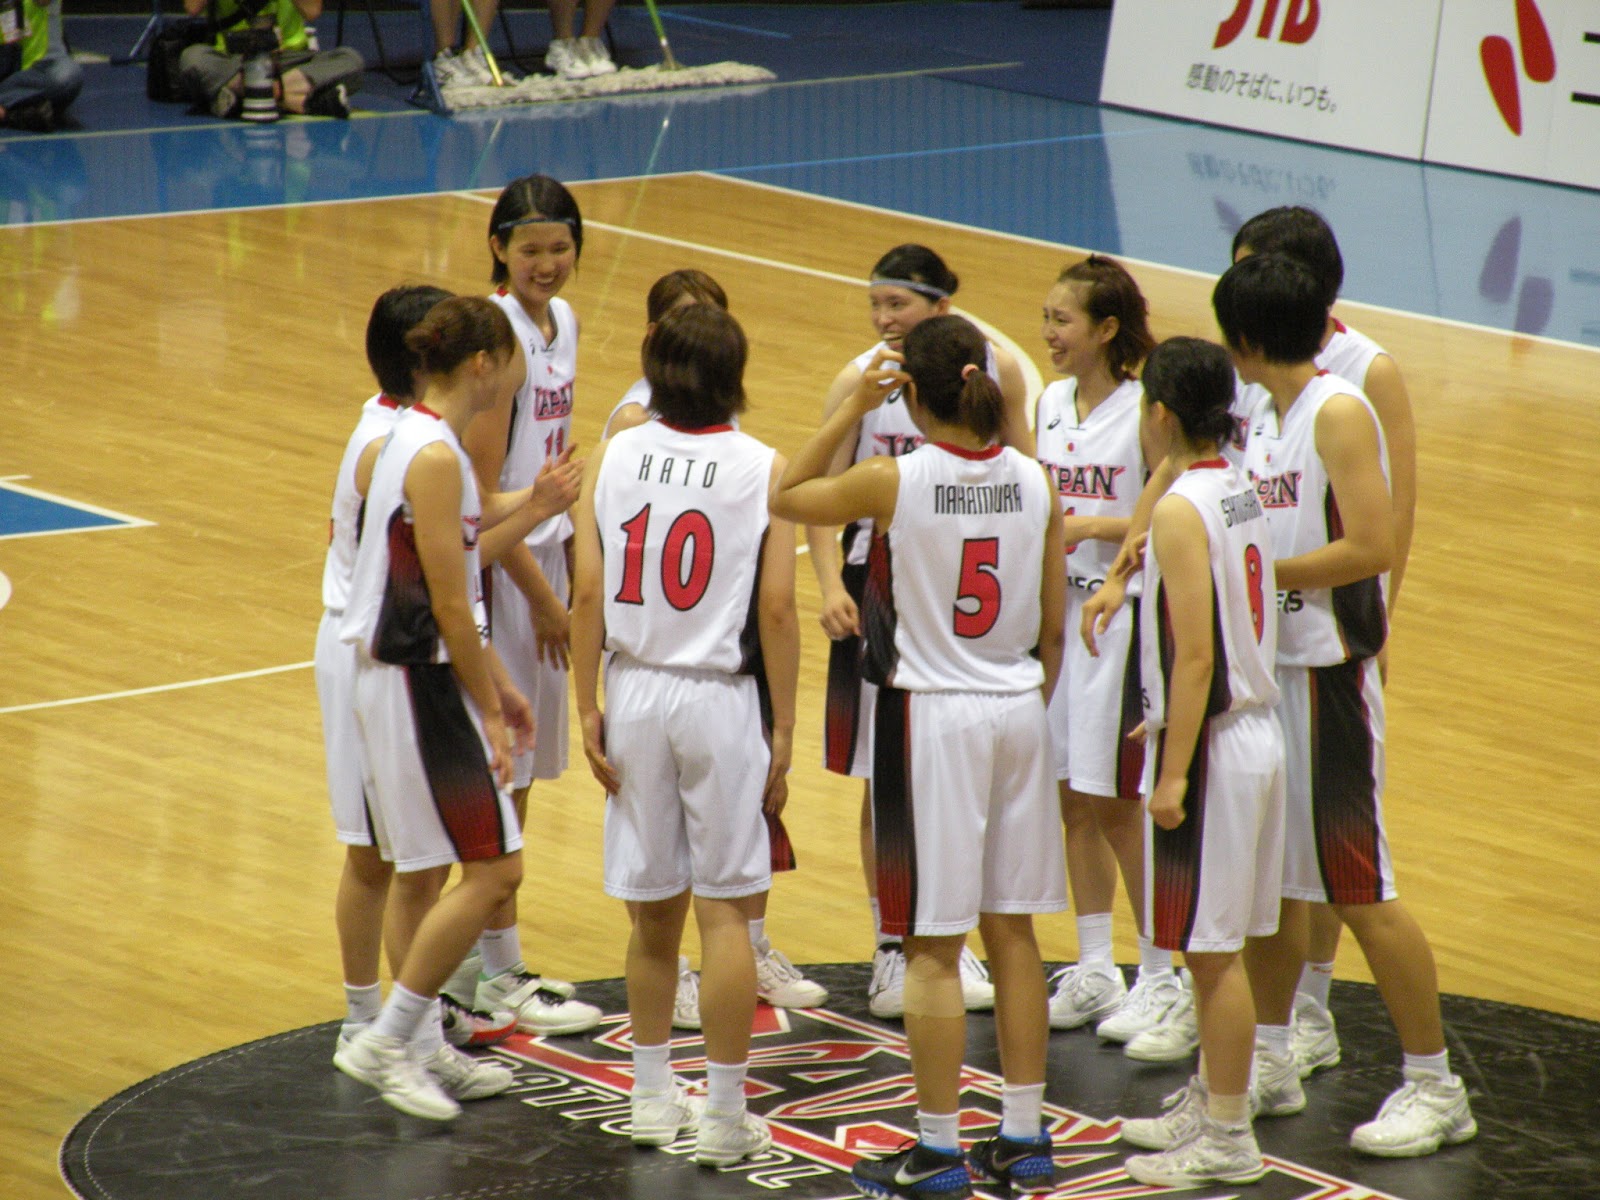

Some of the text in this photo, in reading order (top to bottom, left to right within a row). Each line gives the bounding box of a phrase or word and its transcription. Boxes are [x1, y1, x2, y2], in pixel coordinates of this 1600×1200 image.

[638, 453, 718, 489] KATO
[933, 483, 1023, 515] NAKAMURA
[613, 502, 715, 612] 10
[952, 536, 1002, 639] 5
